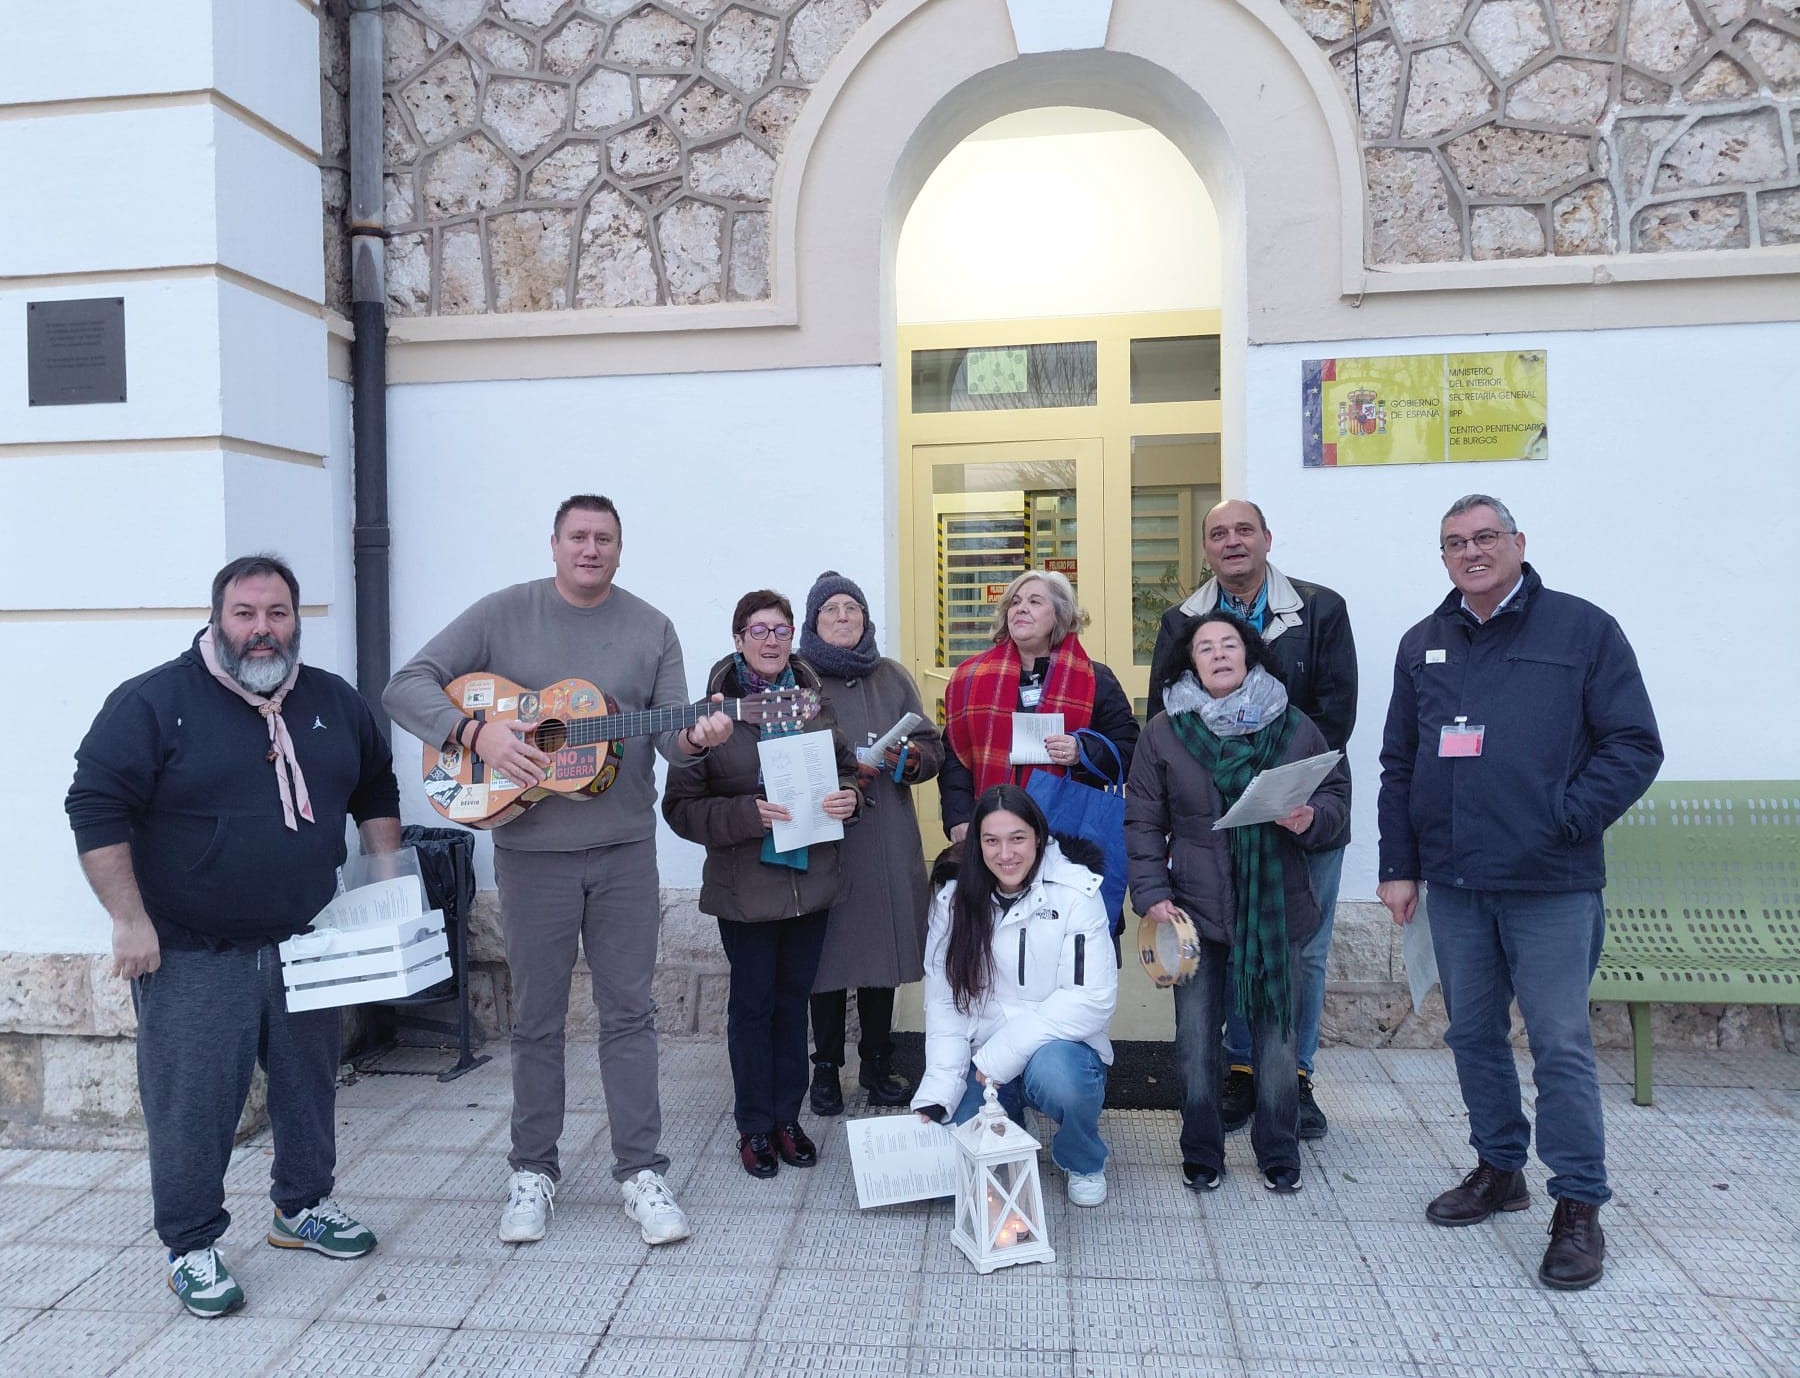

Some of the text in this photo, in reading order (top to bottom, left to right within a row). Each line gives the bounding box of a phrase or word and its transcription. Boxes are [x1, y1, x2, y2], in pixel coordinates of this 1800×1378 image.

[1449, 367, 1493, 377] MINISTERIO
[1449, 378, 1501, 388] DEL INTERIOR
[1498, 390, 1536, 400] GENERAL
[1391, 398, 1440, 408] GOBIERNO
[1391, 411, 1402, 420] DE
[1449, 423, 1545, 435] CENTRO PENITENCIARIO
[1449, 436, 1498, 446] DE BURGOS
[557, 751, 578, 766] NO
[557, 765, 595, 778] GUERRA
[300, 1219, 327, 1241] N
